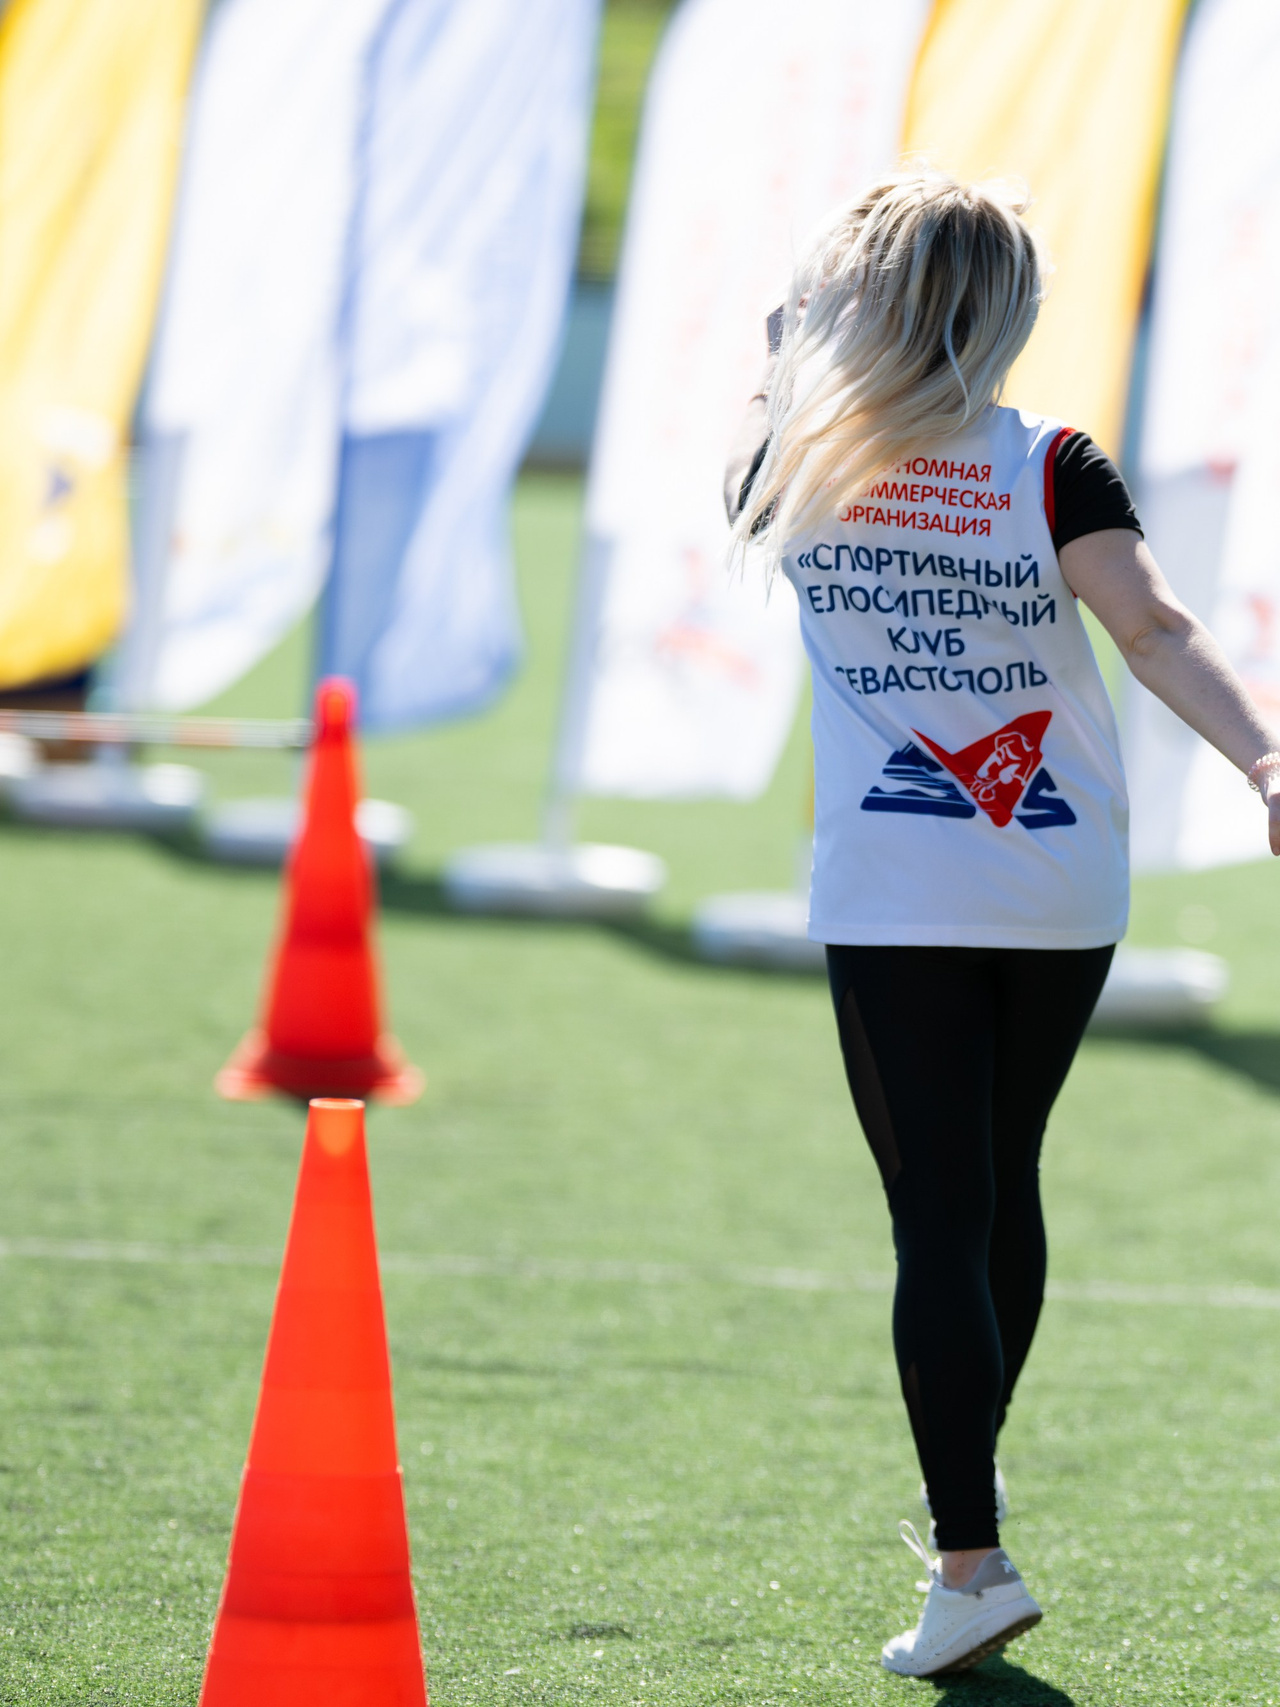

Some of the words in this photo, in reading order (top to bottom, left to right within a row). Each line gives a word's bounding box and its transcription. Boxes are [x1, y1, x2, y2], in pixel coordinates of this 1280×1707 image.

[883, 456, 992, 484] НОМНАЯ
[838, 505, 991, 537] ОРГАНИЗАЦИЯ
[797, 543, 1039, 588] «СПОРТИВНЫЙ
[806, 585, 1056, 628] ЕЛОСИПЕДНЫЙ
